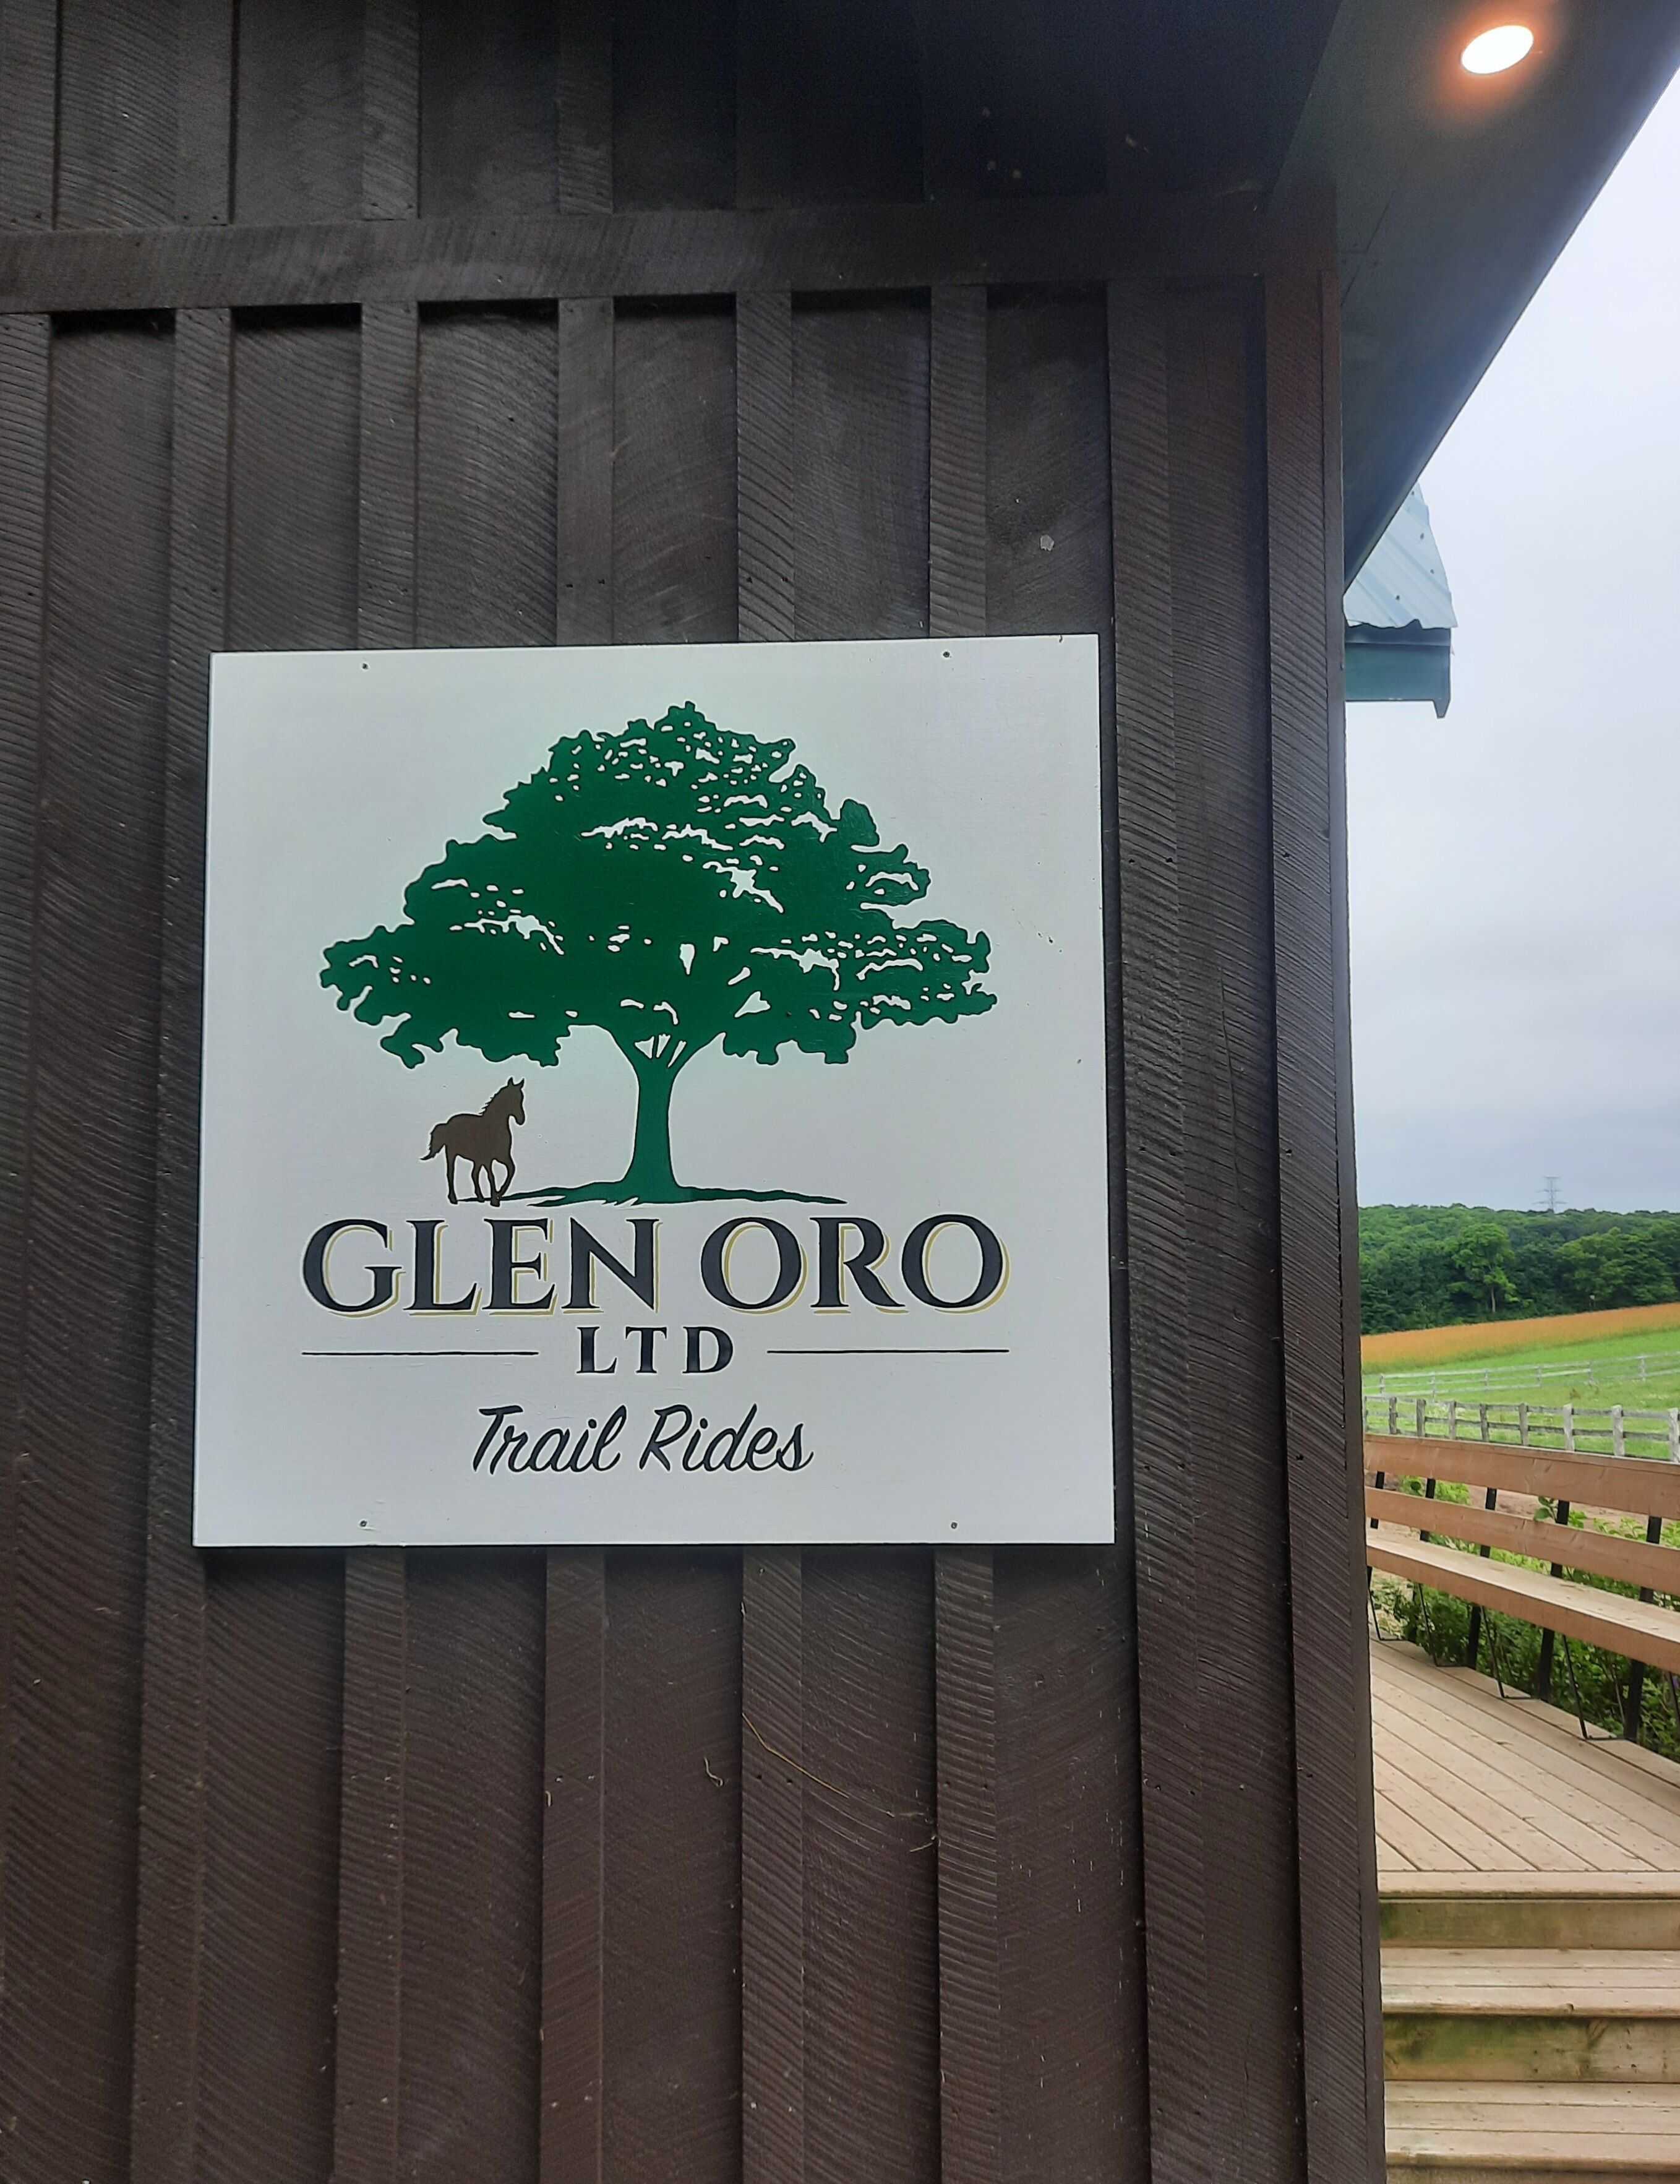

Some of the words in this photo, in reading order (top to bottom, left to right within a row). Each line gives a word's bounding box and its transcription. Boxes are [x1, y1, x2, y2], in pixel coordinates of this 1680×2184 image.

[302, 1217, 661, 1315] GLEN
[700, 1214, 1009, 1314] ORO
[576, 1326, 734, 1374] LTD
[473, 1404, 627, 1475] Trail
[639, 1403, 815, 1472] Rides
